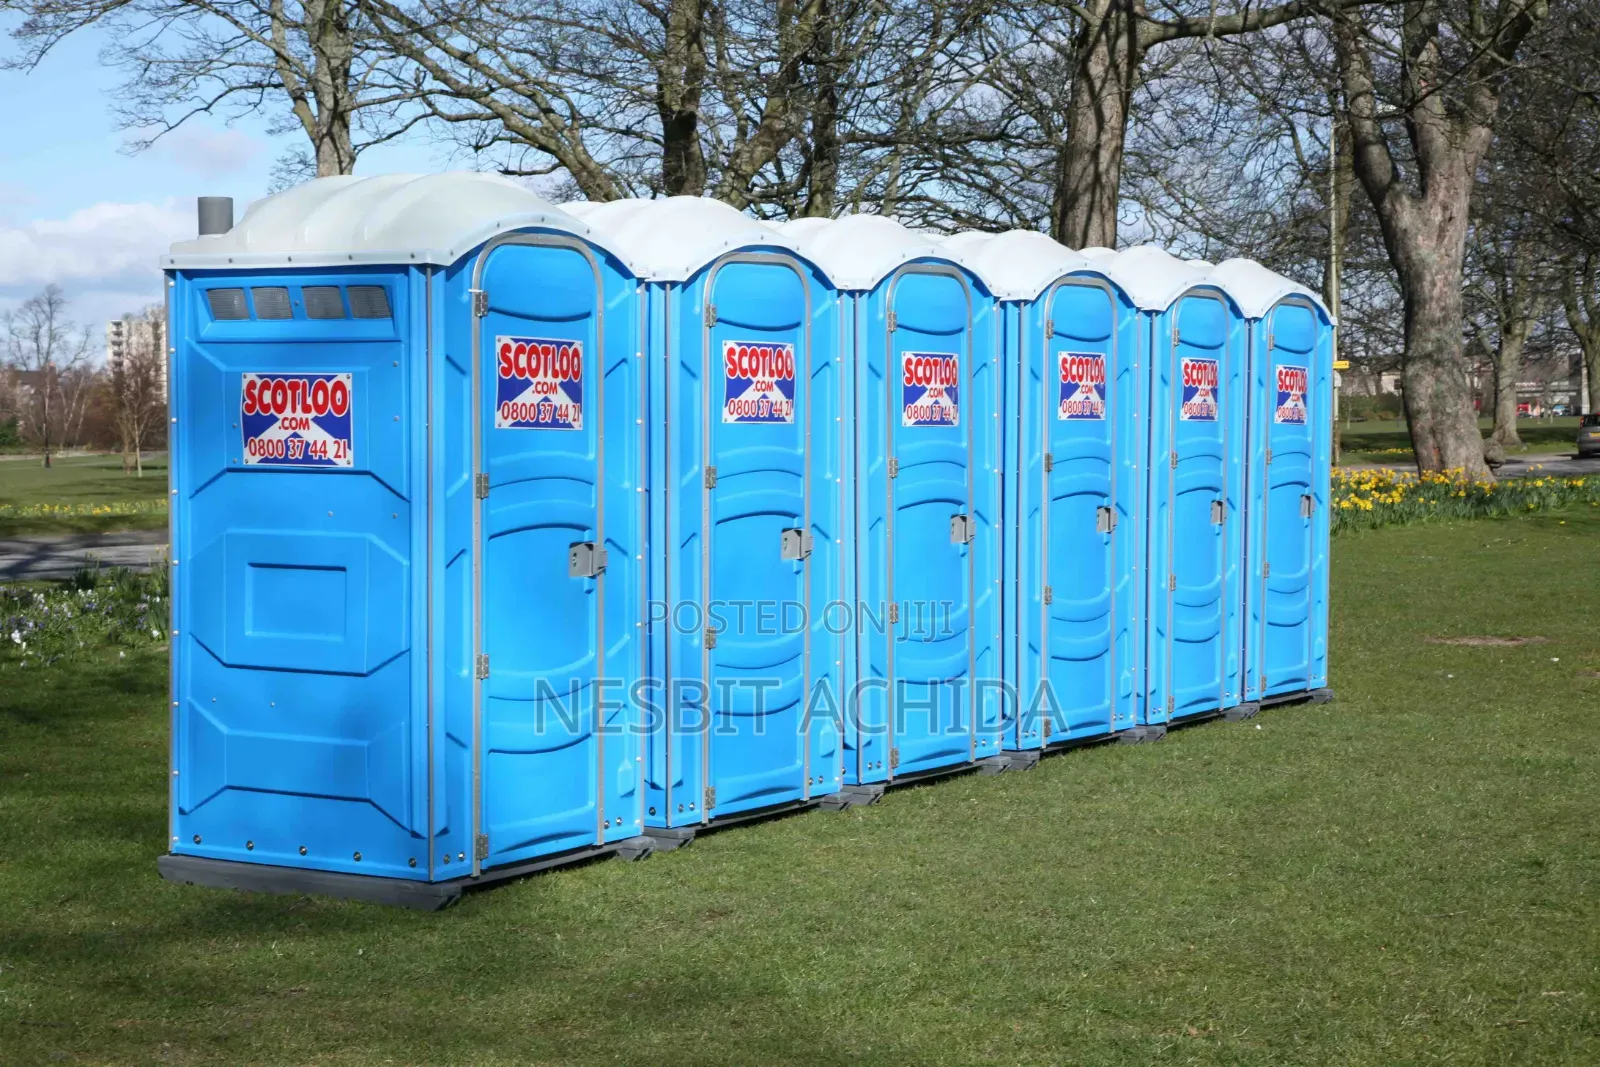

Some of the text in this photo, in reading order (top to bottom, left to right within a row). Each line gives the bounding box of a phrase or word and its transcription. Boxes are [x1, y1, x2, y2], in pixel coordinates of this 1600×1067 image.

[500, 343, 581, 381] SCOTLOO
[726, 347, 794, 379] SCOTLOO
[1061, 357, 1104, 383] SCOTLOO
[904, 357, 957, 386] SCOTLOO
[532, 381, 558, 395] .COM
[753, 380, 773, 392] .COM
[928, 387, 943, 398] .COM
[244, 379, 348, 416] SCOTLOO
[501, 402, 580, 422] 0800 37 44 21
[728, 399, 757, 416] 0800
[759, 400, 770, 416] 37
[773, 400, 782, 416] 44
[906, 405, 931, 420] 0800
[1062, 400, 1082, 414] 0800
[279, 417, 311, 431] .COM
[248, 438, 347, 459] 0800 37 44 21
